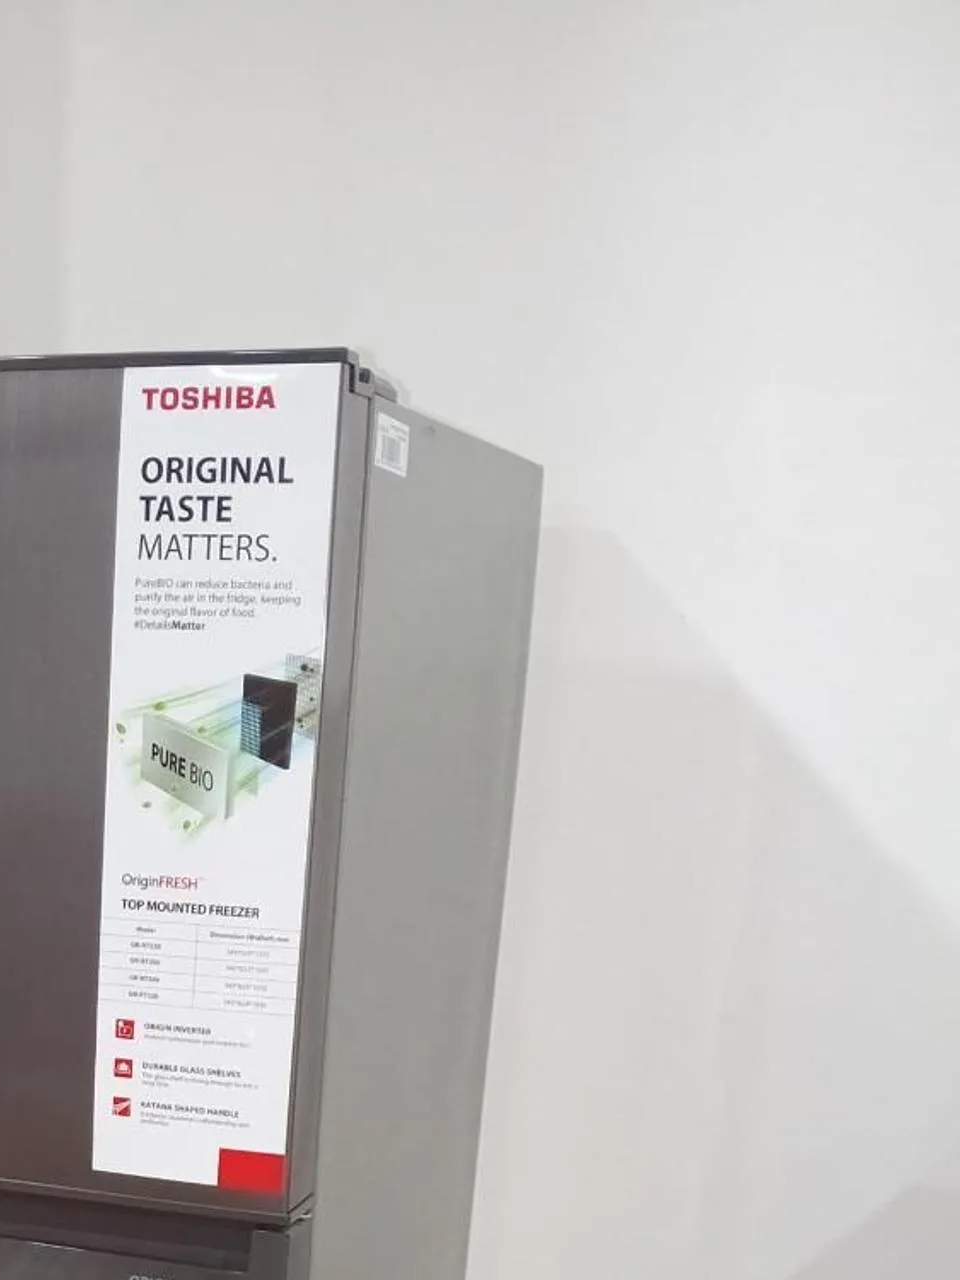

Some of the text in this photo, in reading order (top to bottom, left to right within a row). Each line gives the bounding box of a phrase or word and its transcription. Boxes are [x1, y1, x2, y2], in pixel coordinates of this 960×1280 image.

[142, 386, 276, 410] TOSHIBA
[141, 457, 293, 484] ORIGINAL
[139, 495, 232, 522] TASTE
[138, 533, 277, 562] MATTERS.
[176, 580, 192, 588] can
[196, 579, 228, 589] reduce
[231, 579, 271, 590] bacteria
[273, 581, 293, 590] and
[164, 592, 180, 602] the
[209, 593, 224, 603] the
[134, 606, 149, 616] the
[151, 742, 214, 791] PURE BIO
[122, 899, 260, 919] TOP MOUNTED FREEZER
[142, 1062, 178, 1073] DURABLE
[207, 1107, 240, 1119] HANDLE
